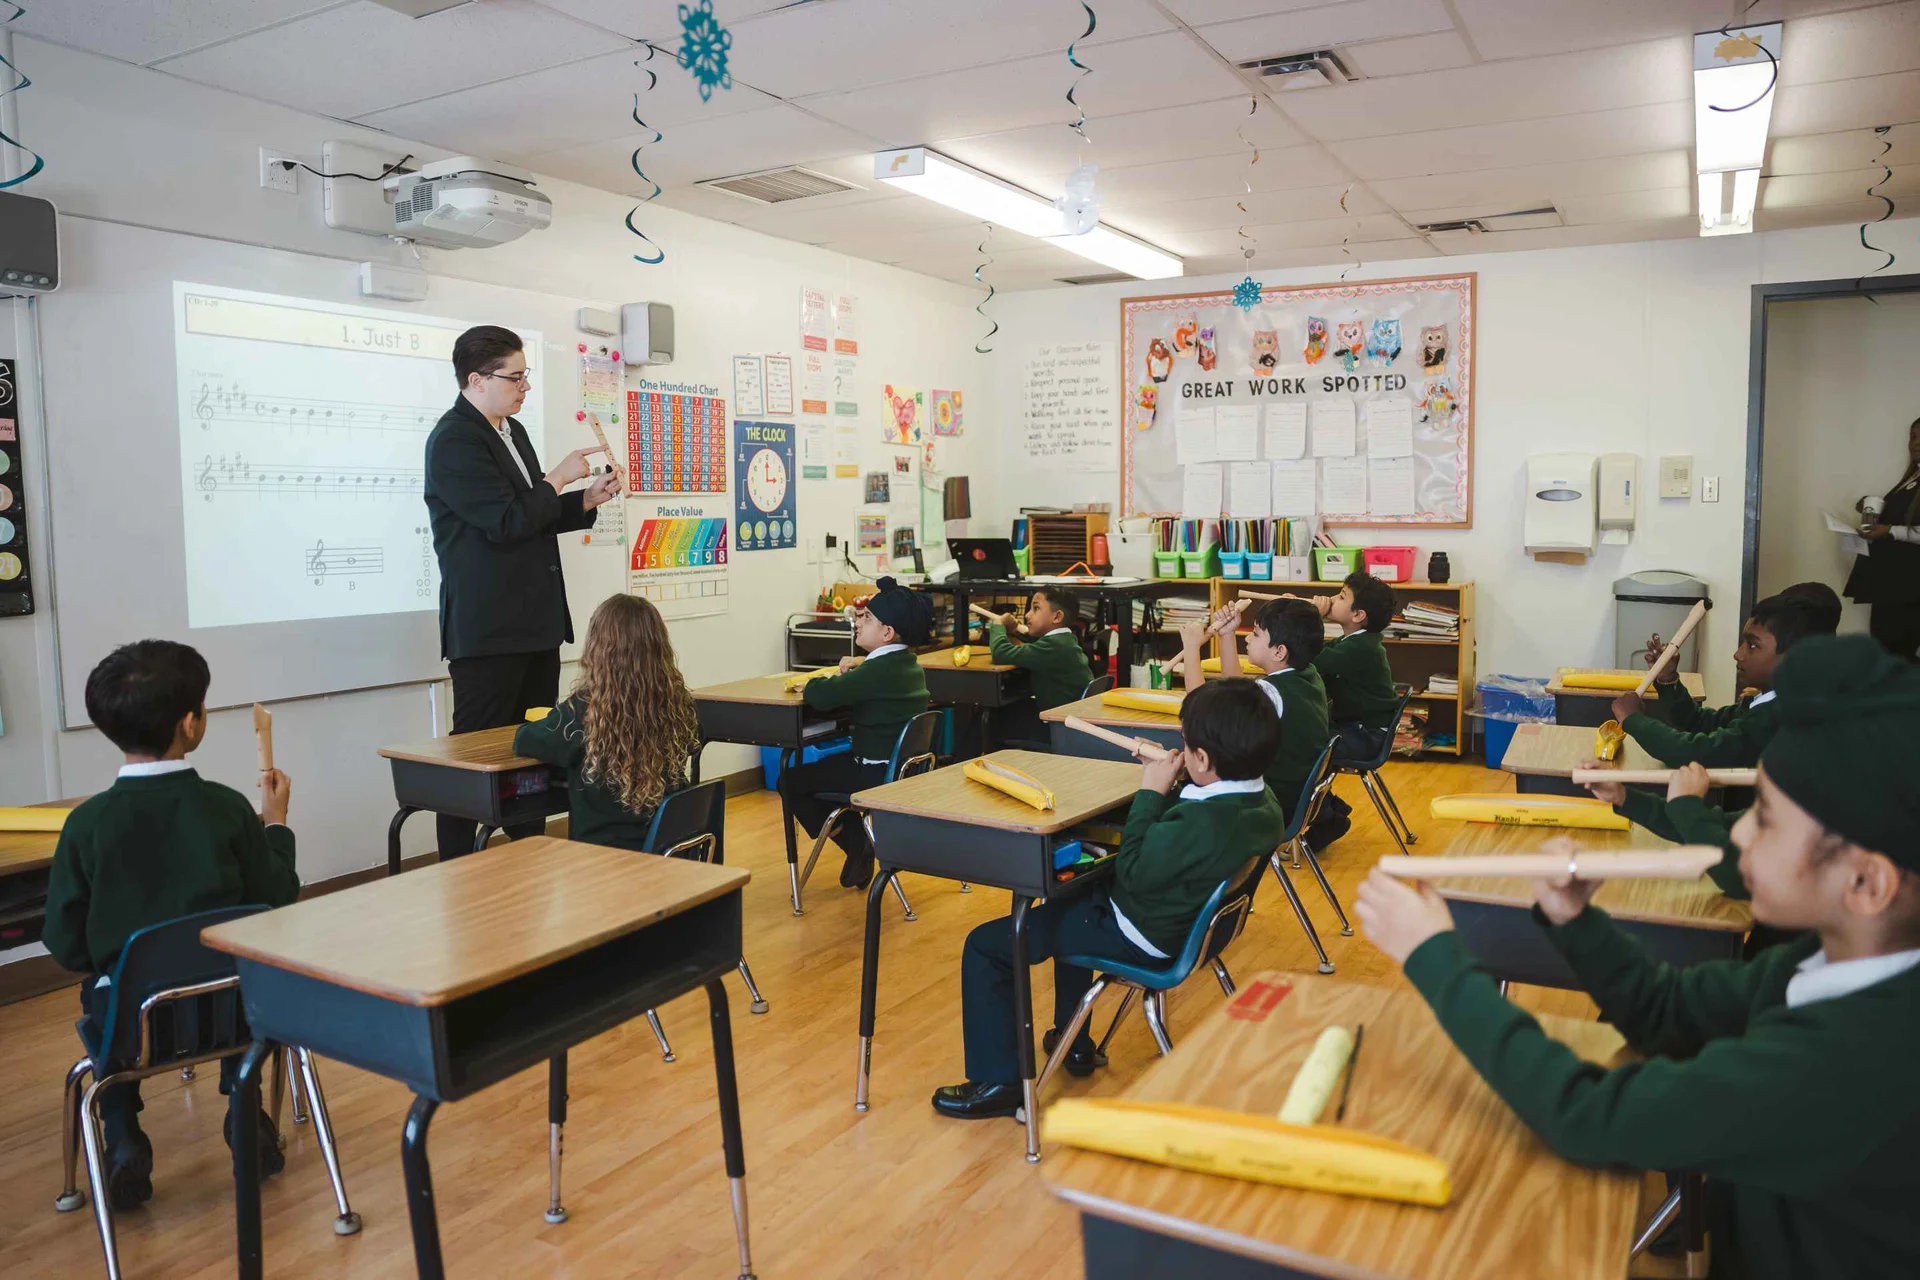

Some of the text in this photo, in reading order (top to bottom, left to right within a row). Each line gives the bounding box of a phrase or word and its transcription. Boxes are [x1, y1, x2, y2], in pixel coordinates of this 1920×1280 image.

[363, 328, 401, 348] Just
[410, 334, 420, 350] B
[640, 379, 718, 396] One Hundred Chart
[1182, 374, 1406, 398] GREAT WORK SPOTTED
[746, 427, 760, 440] THE
[763, 427, 786, 442] CLOCK
[658, 507, 703, 516] Place Value
[651, 555, 656, 566] 5
[665, 554, 671, 565] 6
[693, 552, 698, 563] 7
[706, 551, 711, 563] 9
[719, 551, 724, 562] 8
[349, 581, 356, 590] B
